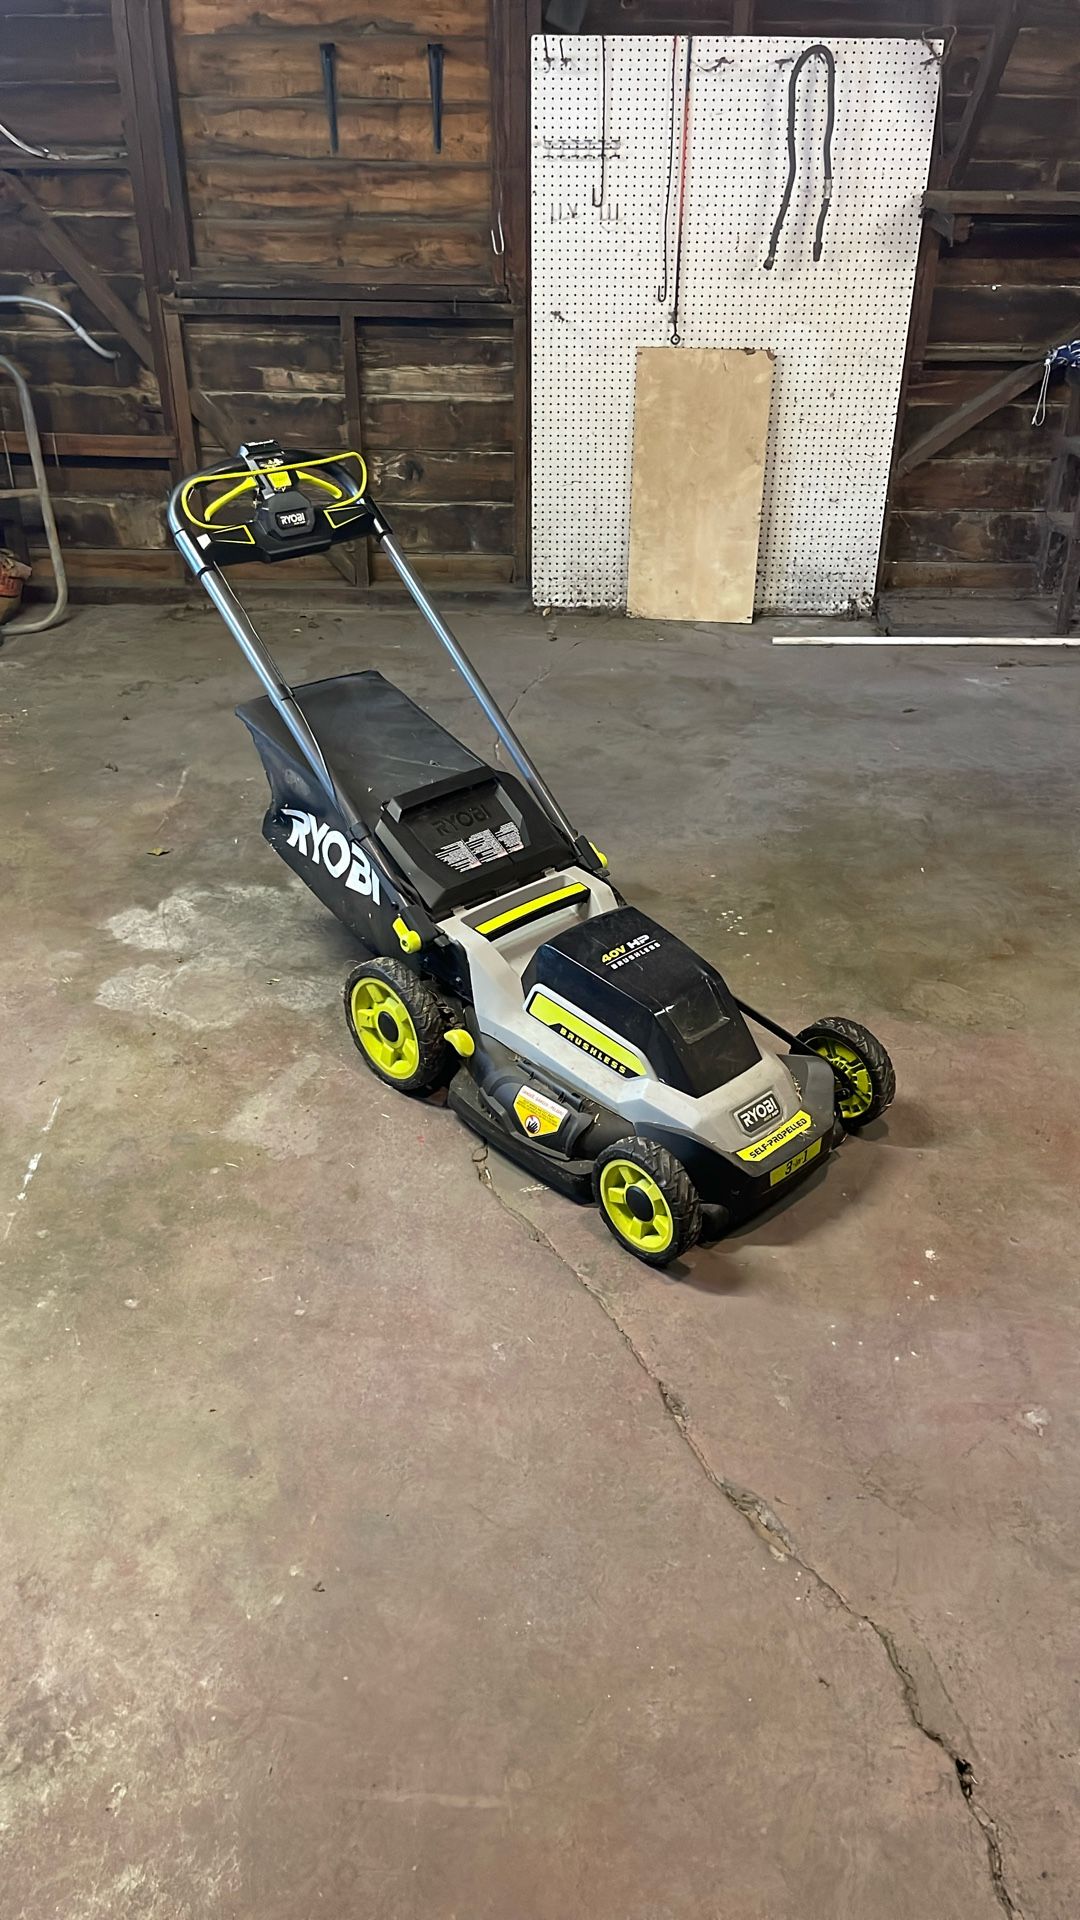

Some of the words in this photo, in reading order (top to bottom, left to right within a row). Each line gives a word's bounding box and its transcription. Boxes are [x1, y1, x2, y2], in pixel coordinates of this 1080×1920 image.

[280, 513, 305, 525] RYOBI
[431, 804, 491, 836] RYOBI
[281, 808, 381, 906] RYOBI
[602, 945, 626, 963] 40V
[626, 934, 650, 949] HP
[560, 1026, 627, 1074] BRUSHLESS
[740, 1097, 778, 1128] RYOBI
[749, 1118, 808, 1159] SELF-PROPELLED
